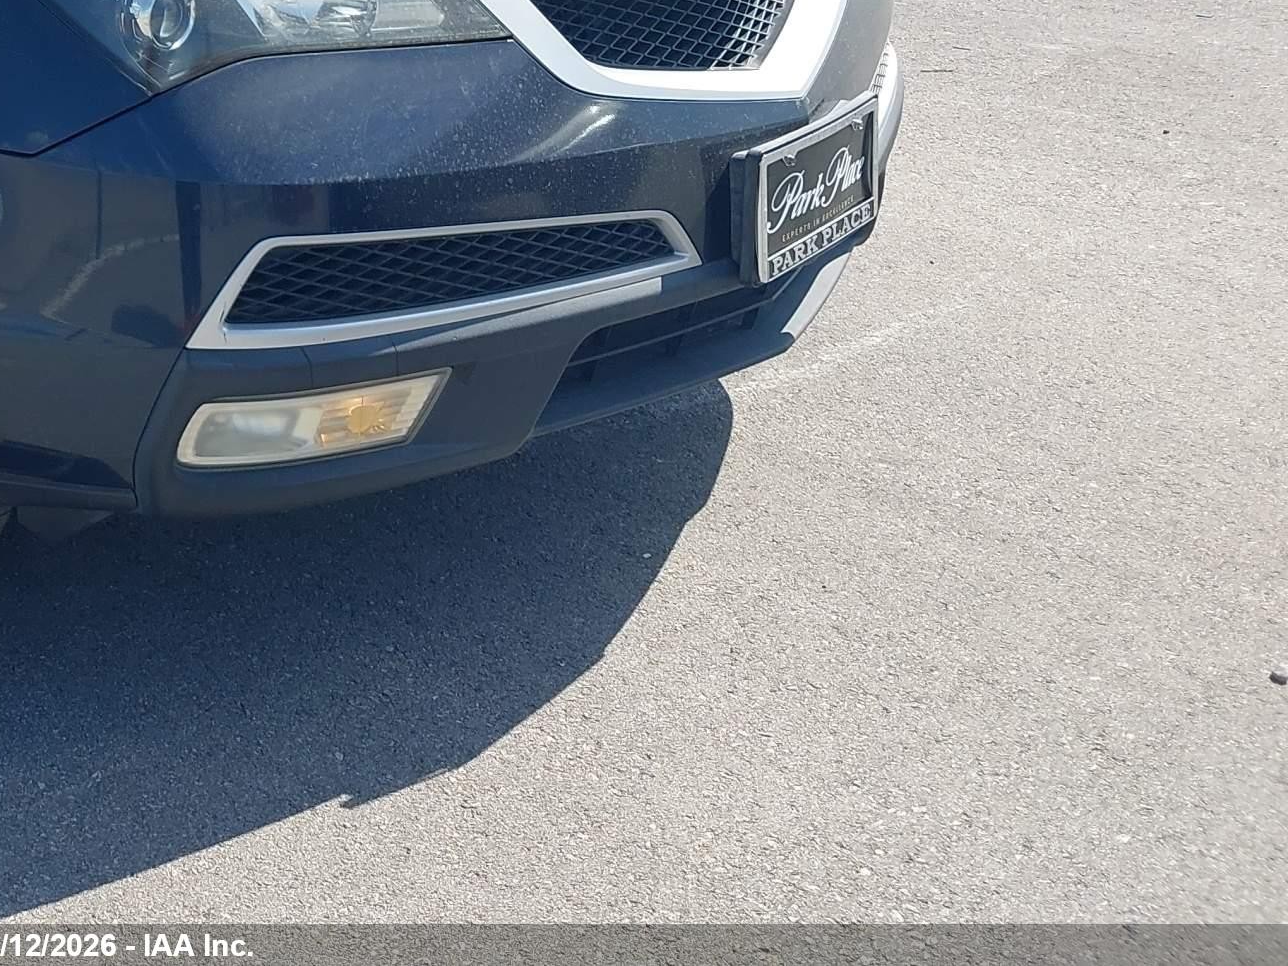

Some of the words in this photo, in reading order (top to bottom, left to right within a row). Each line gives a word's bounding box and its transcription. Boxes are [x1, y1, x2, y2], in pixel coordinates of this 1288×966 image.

[767, 169, 826, 234] Park
[821, 144, 865, 207] Place
[772, 236, 821, 275] PARK
[821, 203, 872, 247] PLACE
[781, 222, 811, 243] EXPERTS
[813, 217, 820, 227] IN
